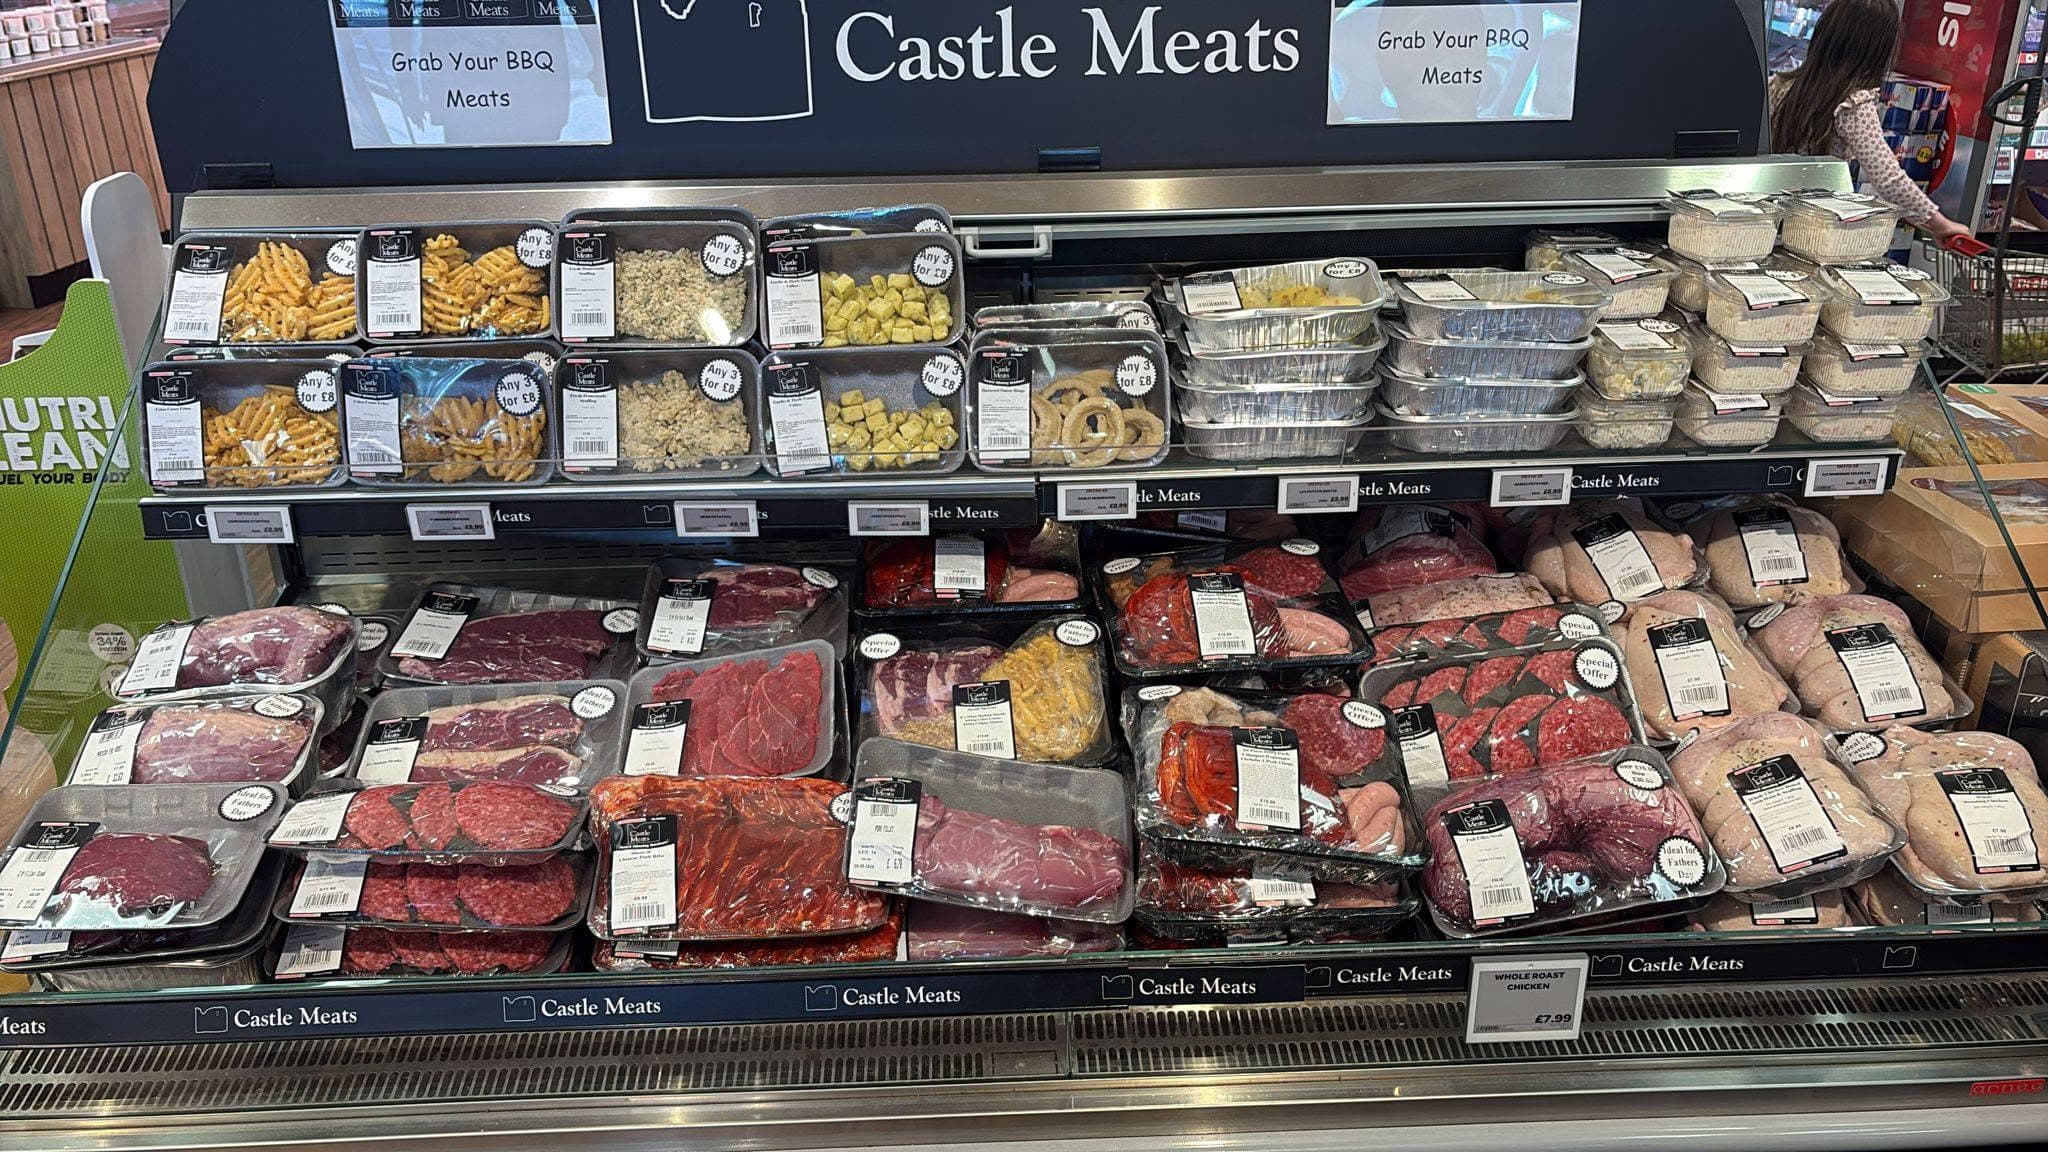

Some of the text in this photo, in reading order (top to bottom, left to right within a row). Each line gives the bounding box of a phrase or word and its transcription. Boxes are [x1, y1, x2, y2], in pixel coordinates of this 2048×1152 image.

[341, 4, 379, 17] Meats
[402, 3, 440, 17] Meats
[471, 3, 509, 16] Meats
[539, 2, 577, 15] Meats
[835, 6, 1300, 82] Castle Meats
[1378, 28, 1530, 50] Grab Your BBQ
[392, 51, 555, 73] Grab Your BBQ
[1422, 66, 1482, 85] Meats
[447, 89, 510, 108] Meats
[521, 235, 552, 247] Any 3
[710, 239, 740, 254] Any 3
[337, 241, 357, 256] Any
[520, 247, 552, 259] for £8
[329, 251, 345, 265] for
[705, 251, 737, 269] for £8
[919, 251, 950, 264] Any 3
[916, 266, 947, 279] for £8
[1120, 317, 1150, 328] Any 3
[707, 365, 738, 380] Any 3
[930, 358, 959, 376] Any 3
[1119, 362, 1151, 376] Any 3
[301, 376, 333, 388] Any 3
[500, 377, 532, 391] Any 3
[705, 378, 735, 394] for £8
[925, 371, 955, 390] for £8
[1121, 376, 1152, 386] for £8
[301, 392, 334, 402] for £8
[502, 394, 535, 407] for £8
[32, 473, 75, 485] YOUR
[1571, 473, 1660, 489] Castle Meats
[1359, 481, 1431, 496] stle Meats
[1157, 489, 1201, 503] Meats
[929, 506, 999, 519] stle Meats
[1561, 621, 1595, 632] Special
[1565, 629, 1592, 638] Offer
[97, 637, 127, 646] 34%
[863, 639, 897, 648] Special
[865, 646, 890, 654] Offer
[1580, 656, 1614, 670] Special
[1582, 667, 1609, 680] Offer
[1347, 702, 1383, 720] Special
[1348, 711, 1377, 724] Offer
[238, 789, 271, 800] Ideal for
[231, 799, 262, 811] Fathers
[230, 808, 249, 817] Day
[1663, 847, 1696, 855] Ideal for
[1668, 858, 1698, 867] Fathers
[1679, 871, 1693, 879] Day
[1628, 955, 1744, 974] Castle Meats
[1336, 965, 1452, 984] Castle Meats
[1495, 971, 1565, 981] WHOLE ROAST
[1139, 977, 1256, 996] Castle Meats
[1507, 982, 1550, 991] CHICKEN
[843, 985, 961, 1006] Castle Meats
[541, 996, 662, 1018] Castle Meats
[234, 1006, 357, 1027] Castle Meats
[1535, 1013, 1572, 1024] £7.99
